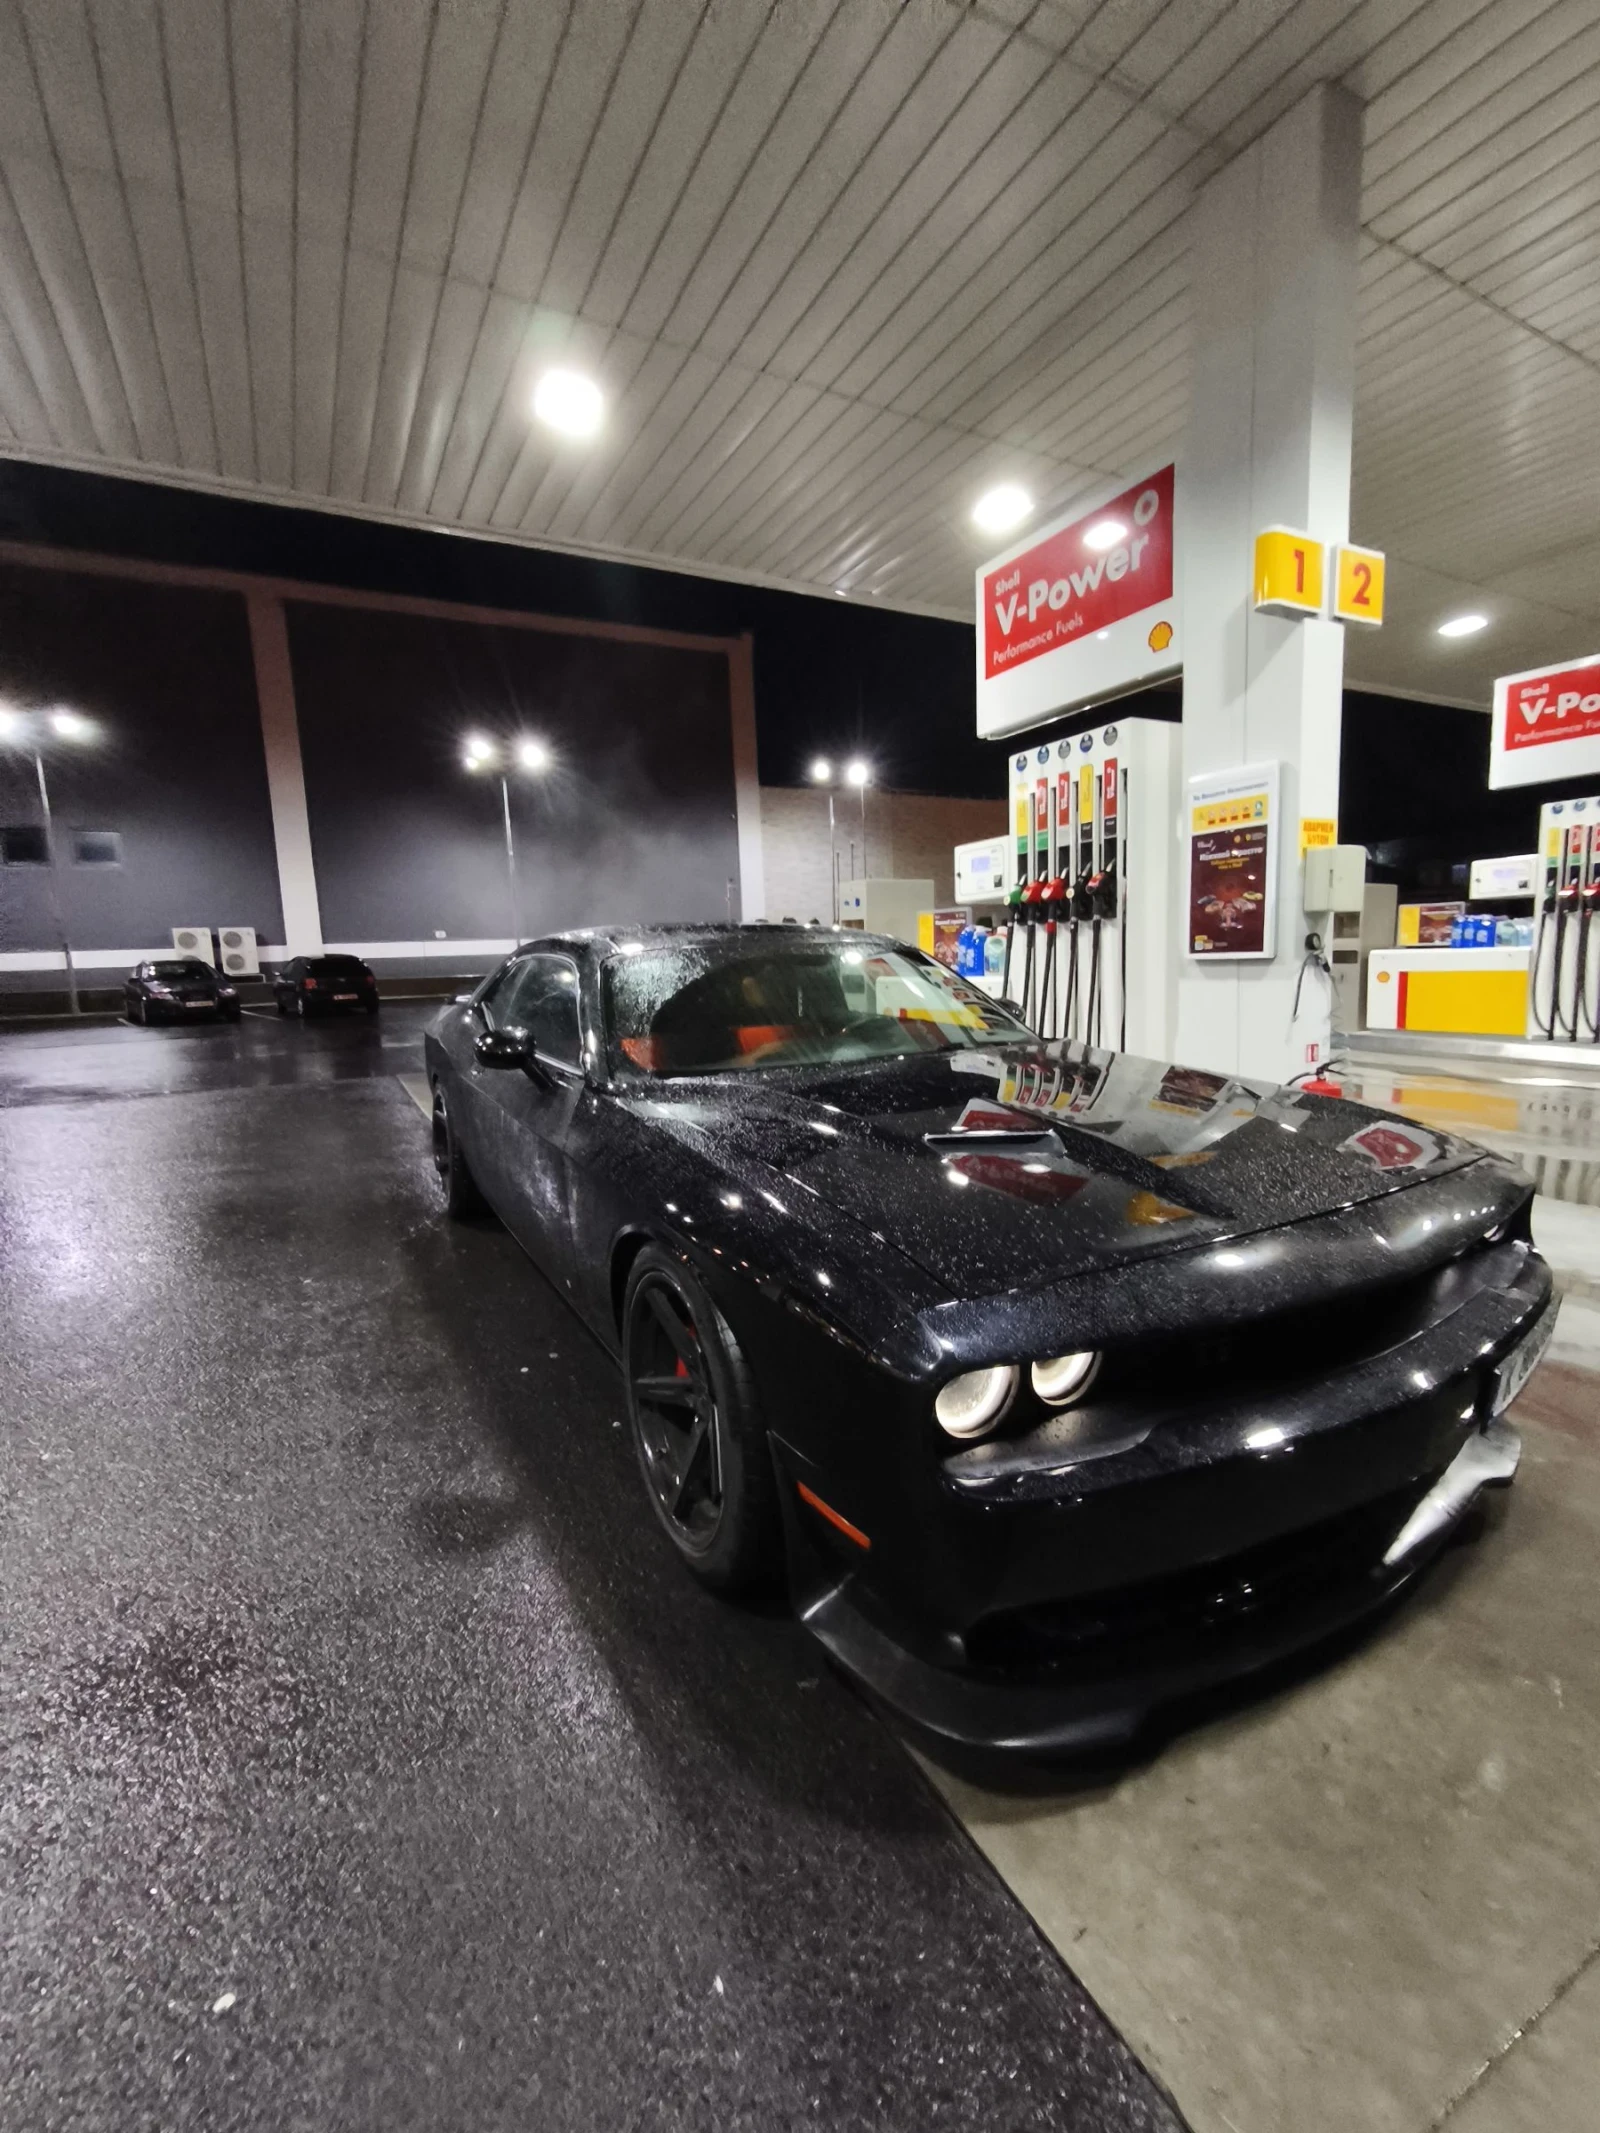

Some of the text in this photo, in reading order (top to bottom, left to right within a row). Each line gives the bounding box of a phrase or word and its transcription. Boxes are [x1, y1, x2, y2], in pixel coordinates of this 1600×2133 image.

[995, 569, 1021, 597] Shell
[995, 533, 1150, 636] V-Power
[1294, 549, 1305, 592] 1
[1352, 562, 1371, 605] 2
[993, 612, 1084, 666] Performance Fuels
